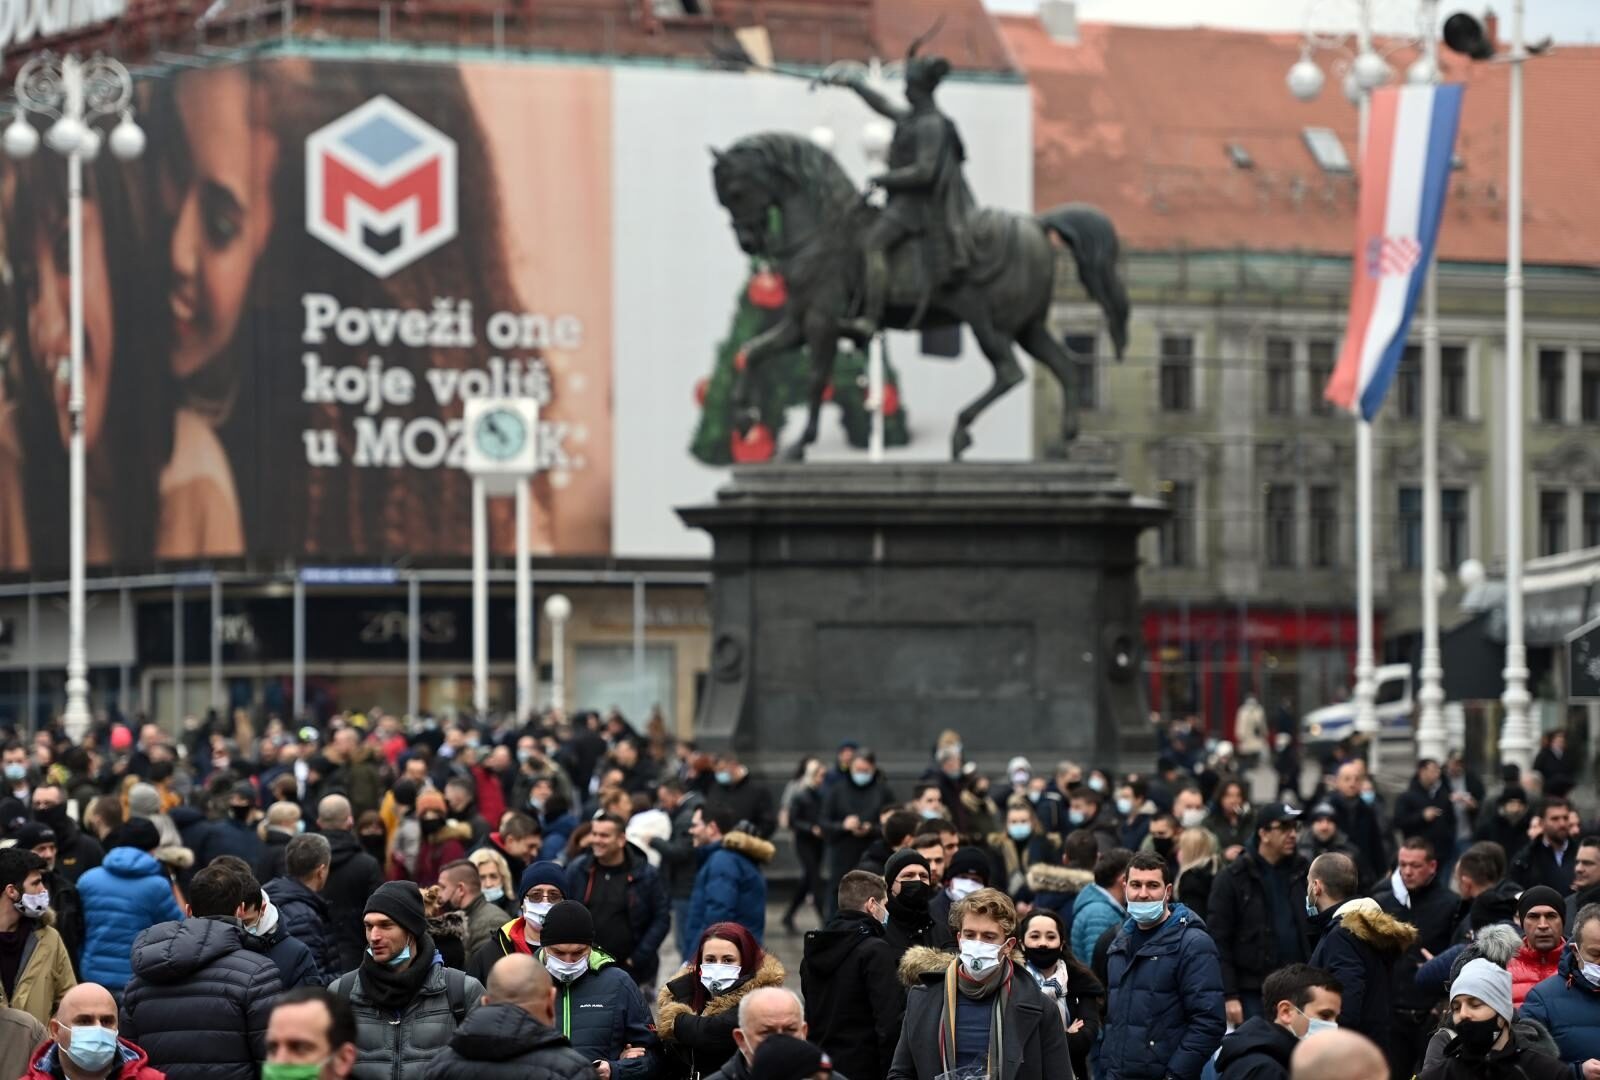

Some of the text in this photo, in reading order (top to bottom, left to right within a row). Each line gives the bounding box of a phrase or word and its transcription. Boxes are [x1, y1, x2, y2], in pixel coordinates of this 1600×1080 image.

[302, 293, 582, 349] Poveži one
[302, 353, 551, 415] koje voliš
[302, 428, 340, 466] u
